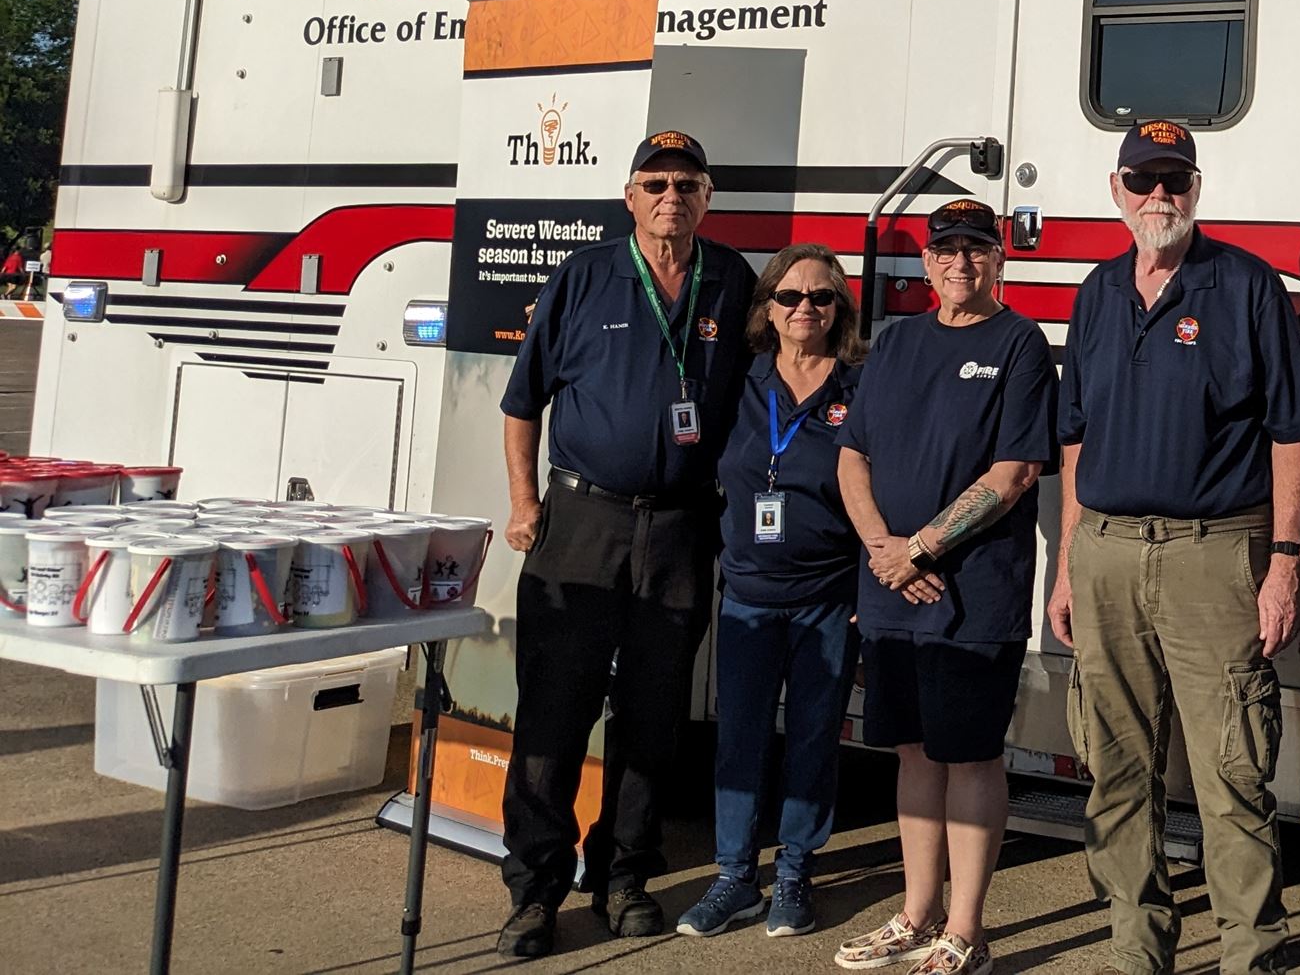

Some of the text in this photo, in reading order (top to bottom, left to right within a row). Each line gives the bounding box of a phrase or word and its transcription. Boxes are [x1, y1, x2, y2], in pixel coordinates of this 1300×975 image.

[303, 15, 386, 46] Office
[397, 11, 428, 42] of
[486, 219, 603, 241] Severe Weather
[478, 243, 573, 267] season is up
[492, 270, 527, 284] important
[528, 274, 536, 283] to
[536, 273, 549, 283] kn
[494, 329, 525, 341] www.Kn
[976, 366, 1000, 376] FIRE
[470, 749, 509, 772] Think.Prep
